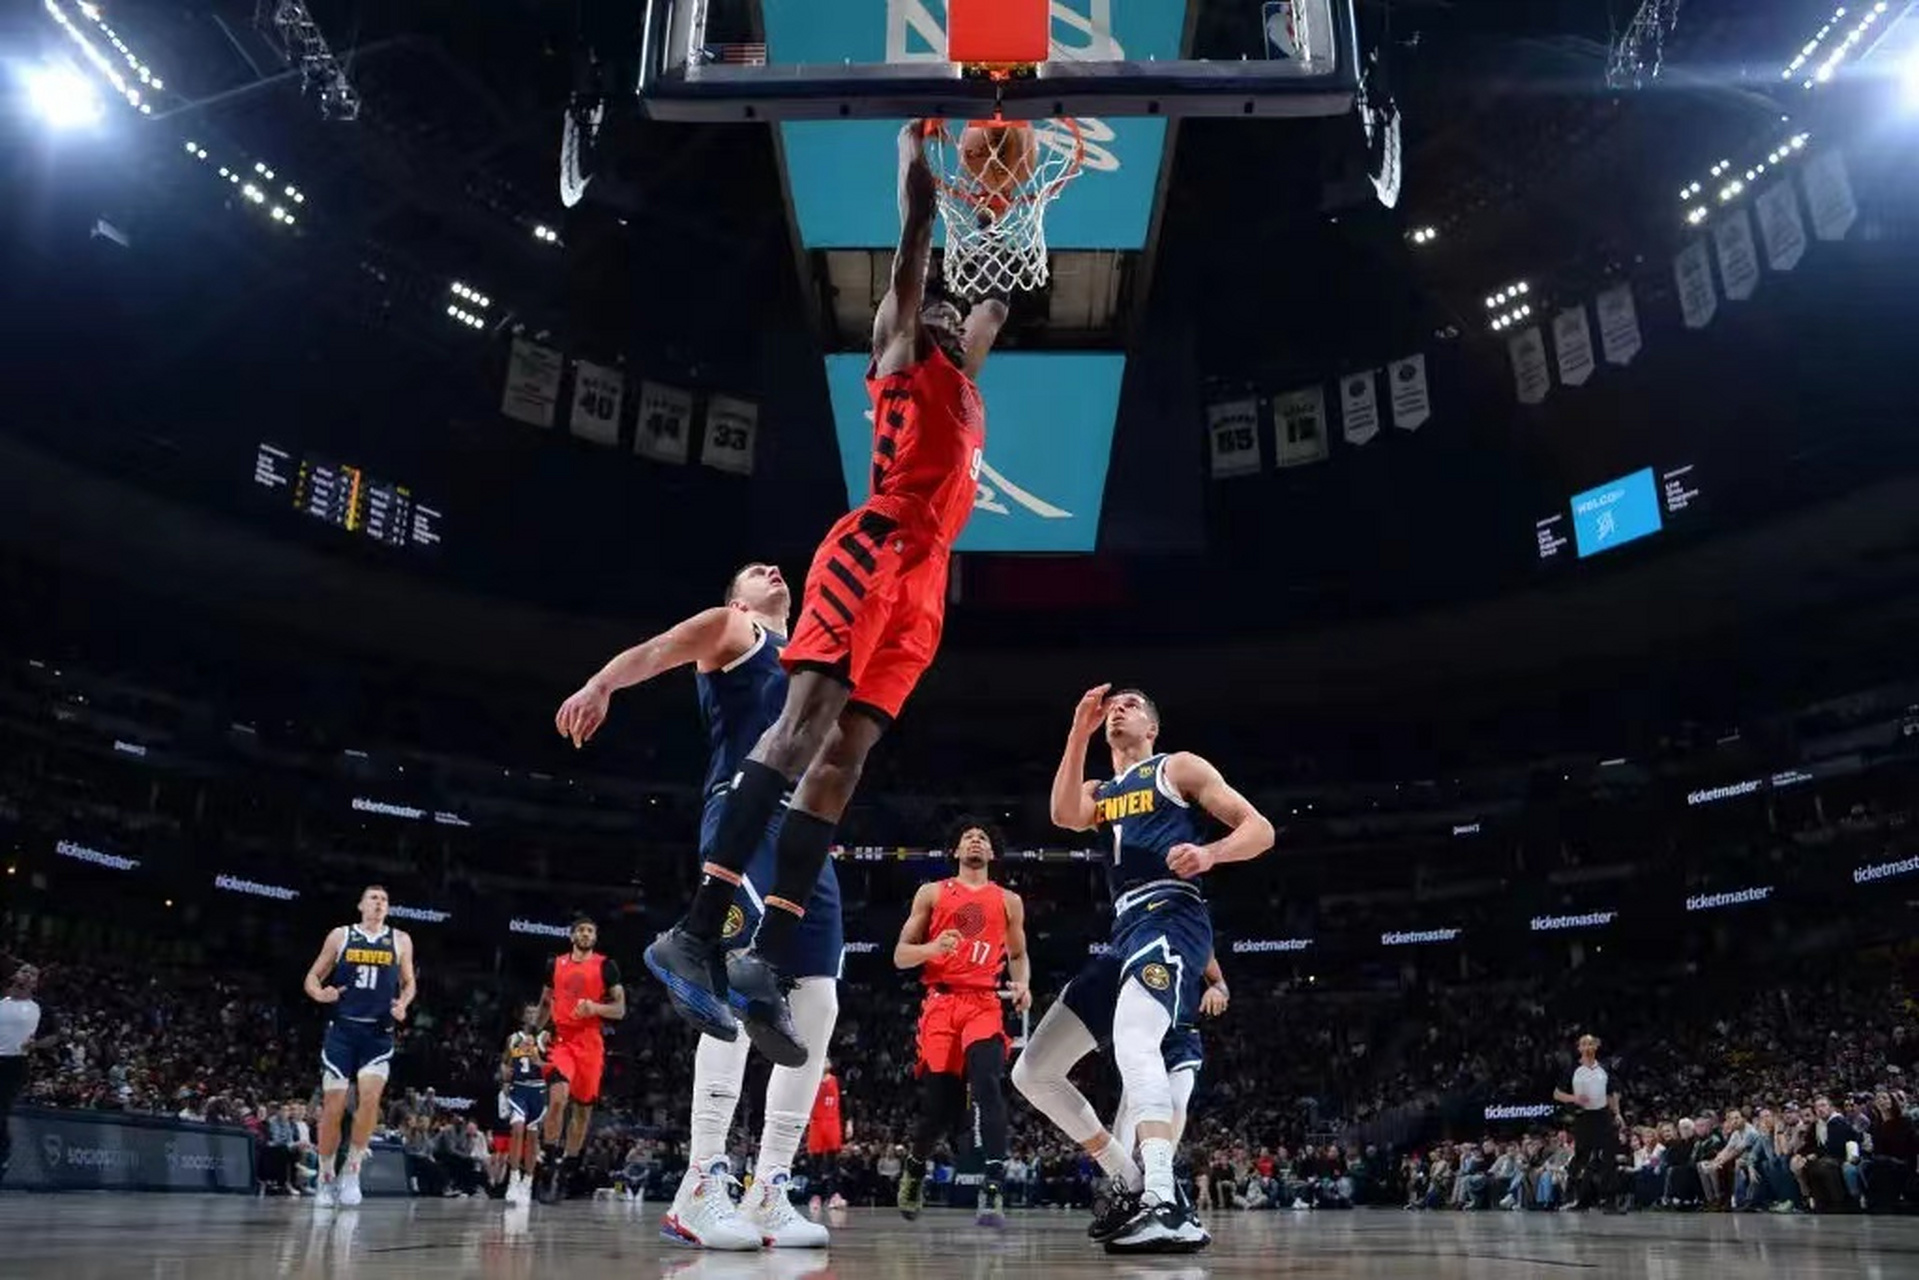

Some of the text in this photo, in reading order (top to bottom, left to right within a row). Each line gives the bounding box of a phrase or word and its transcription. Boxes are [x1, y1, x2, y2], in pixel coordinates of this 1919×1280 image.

[715, 424, 747, 450] 33
[969, 447, 983, 481] 9
[1687, 779, 1762, 805] ticketmaster
[351, 797, 426, 819] ticketmaster
[1095, 789, 1155, 822] ENVER
[56, 840, 141, 870] ticketmaster
[1853, 856, 1919, 884] ticketmast
[215, 874, 300, 901] ticketmaster
[1686, 885, 1773, 911] ticketmaster
[389, 904, 451, 923] etmaster
[1530, 911, 1618, 931] ticketmaster
[510, 917, 572, 940] ticketmast
[1381, 928, 1462, 945] ticketmaster
[346, 948, 393, 966] DENVER
[971, 940, 991, 965] 17
[1232, 937, 1313, 953] ticketmaster
[355, 964, 379, 990] 31
